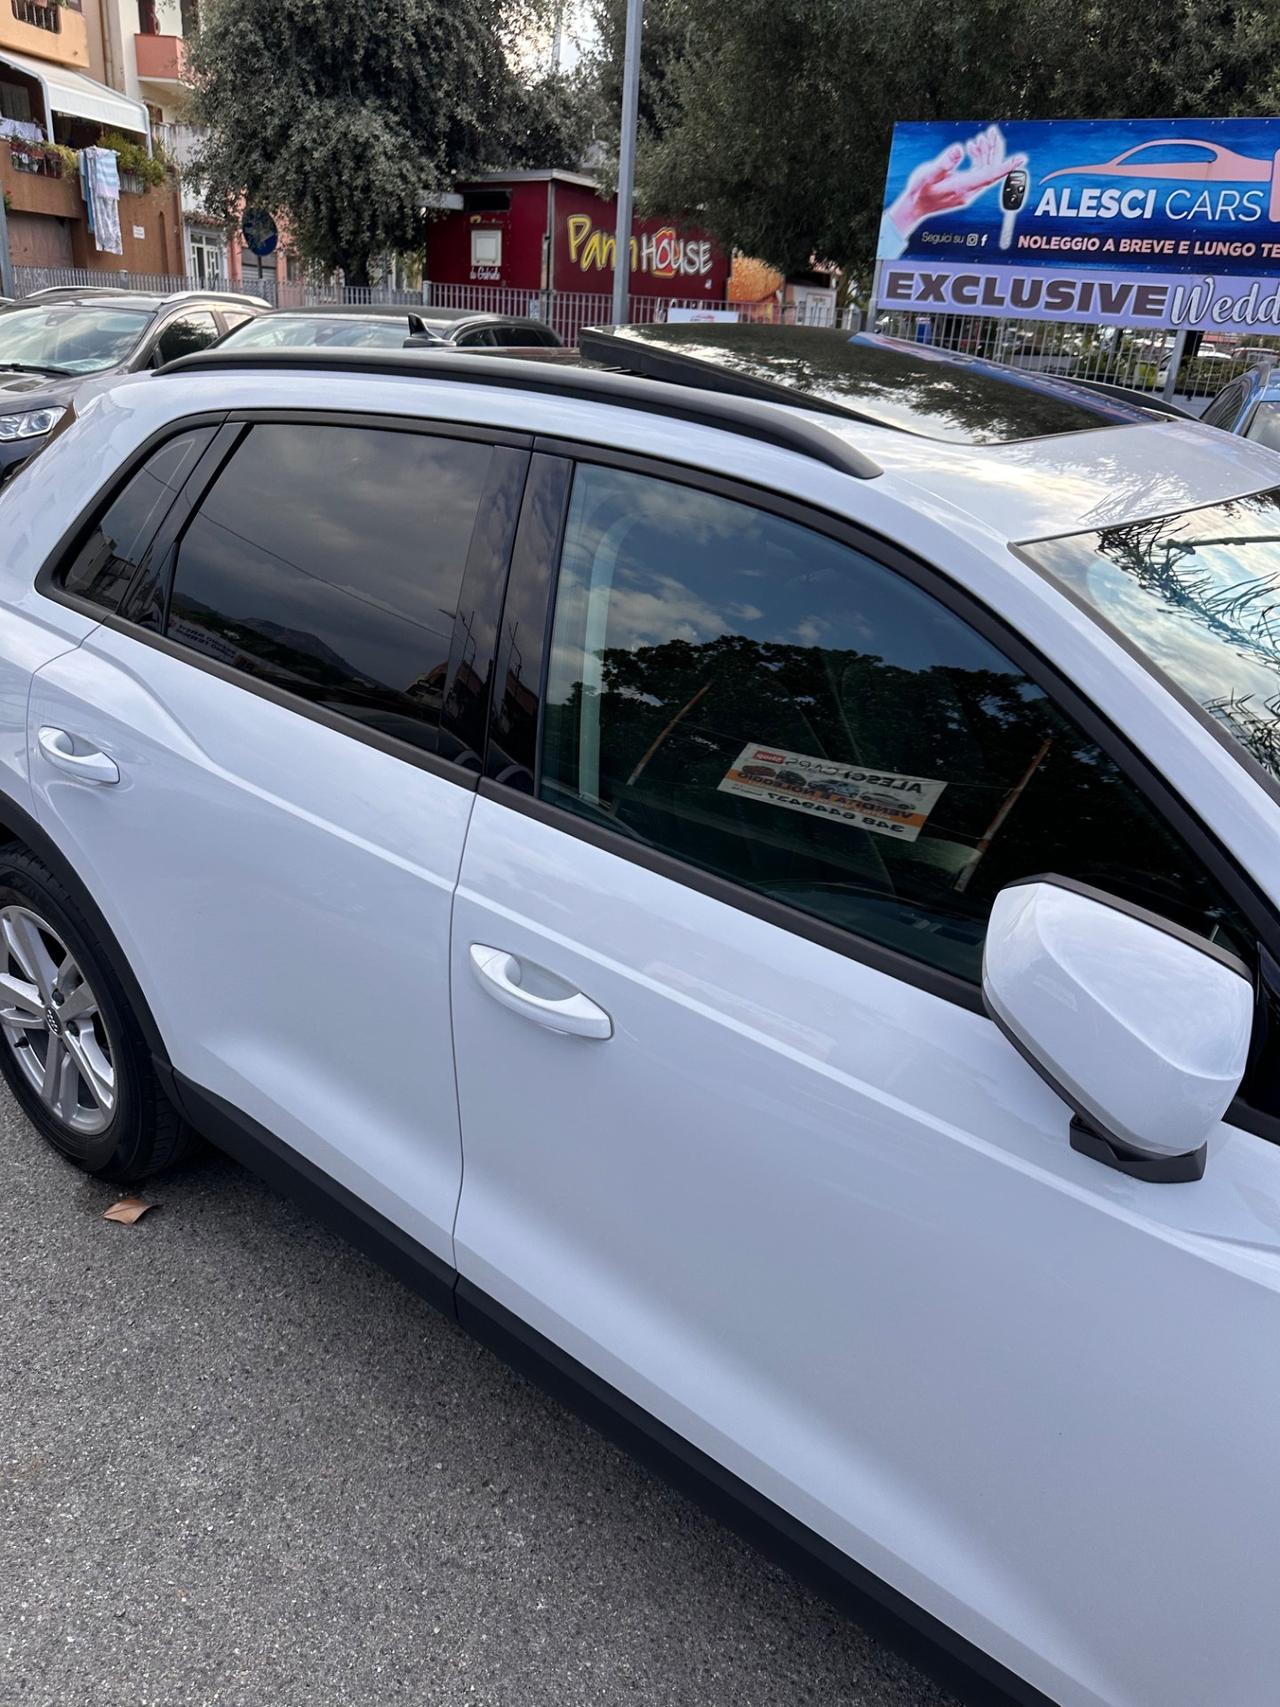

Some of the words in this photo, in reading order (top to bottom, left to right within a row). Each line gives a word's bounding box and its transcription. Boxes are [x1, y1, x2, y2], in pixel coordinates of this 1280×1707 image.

[1034, 188, 1157, 219] ALESCI
[1165, 189, 1264, 221] CARS
[641, 233, 713, 275] HOUSE
[921, 231, 951, 246] Seguici
[953, 236, 964, 244] su
[1017, 235, 1101, 252] NOLEGGIO
[1103, 238, 1115, 252] A
[1119, 238, 1175, 255] BREVE
[1178, 241, 1190, 255] E
[1193, 241, 1256, 257] LUNGO
[885, 271, 1170, 318] EXCLUSIVE
